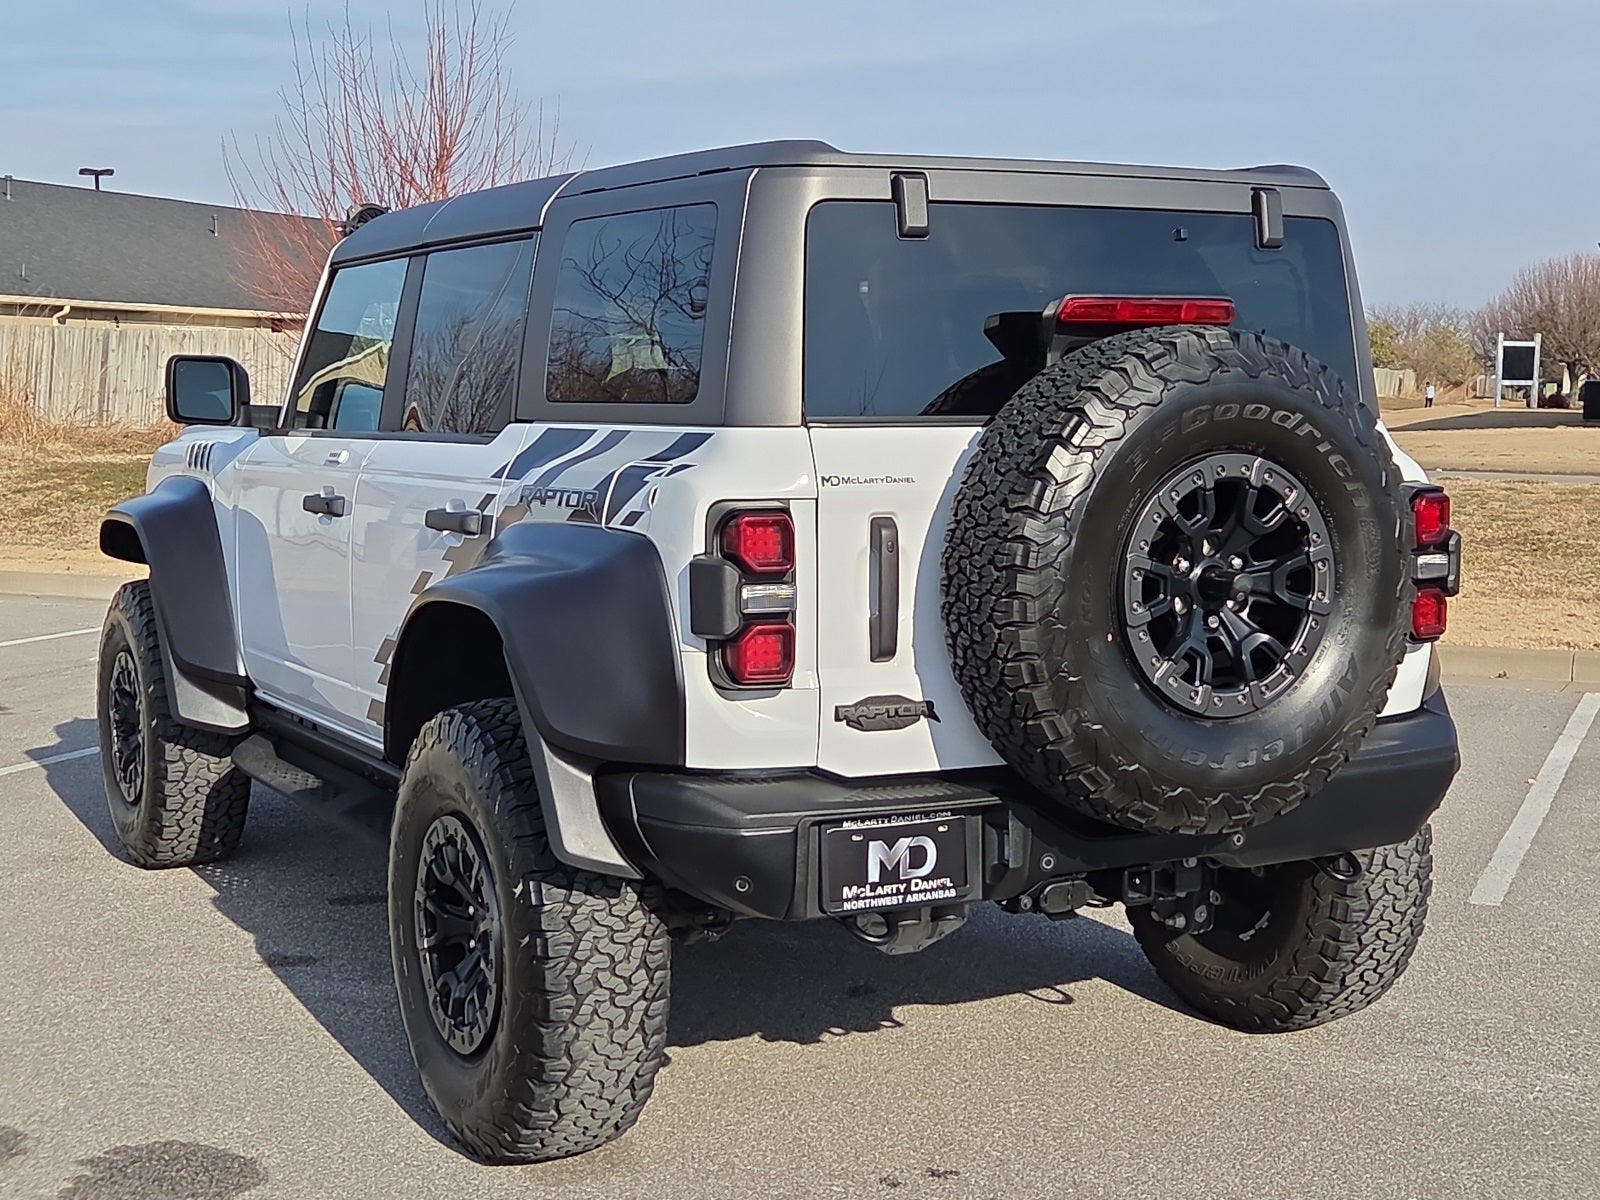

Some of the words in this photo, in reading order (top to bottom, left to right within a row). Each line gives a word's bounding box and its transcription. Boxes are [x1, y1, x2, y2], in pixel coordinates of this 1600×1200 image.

[821, 475, 840, 487] MD
[520, 484, 599, 523] RAPTOR
[834, 700, 941, 728] RAPTOR
[867, 835, 938, 883] MD
[911, 877, 954, 892] DANIEL
[843, 895, 905, 911] NORTHWEST
[906, 888, 957, 903] ARKANSAS
